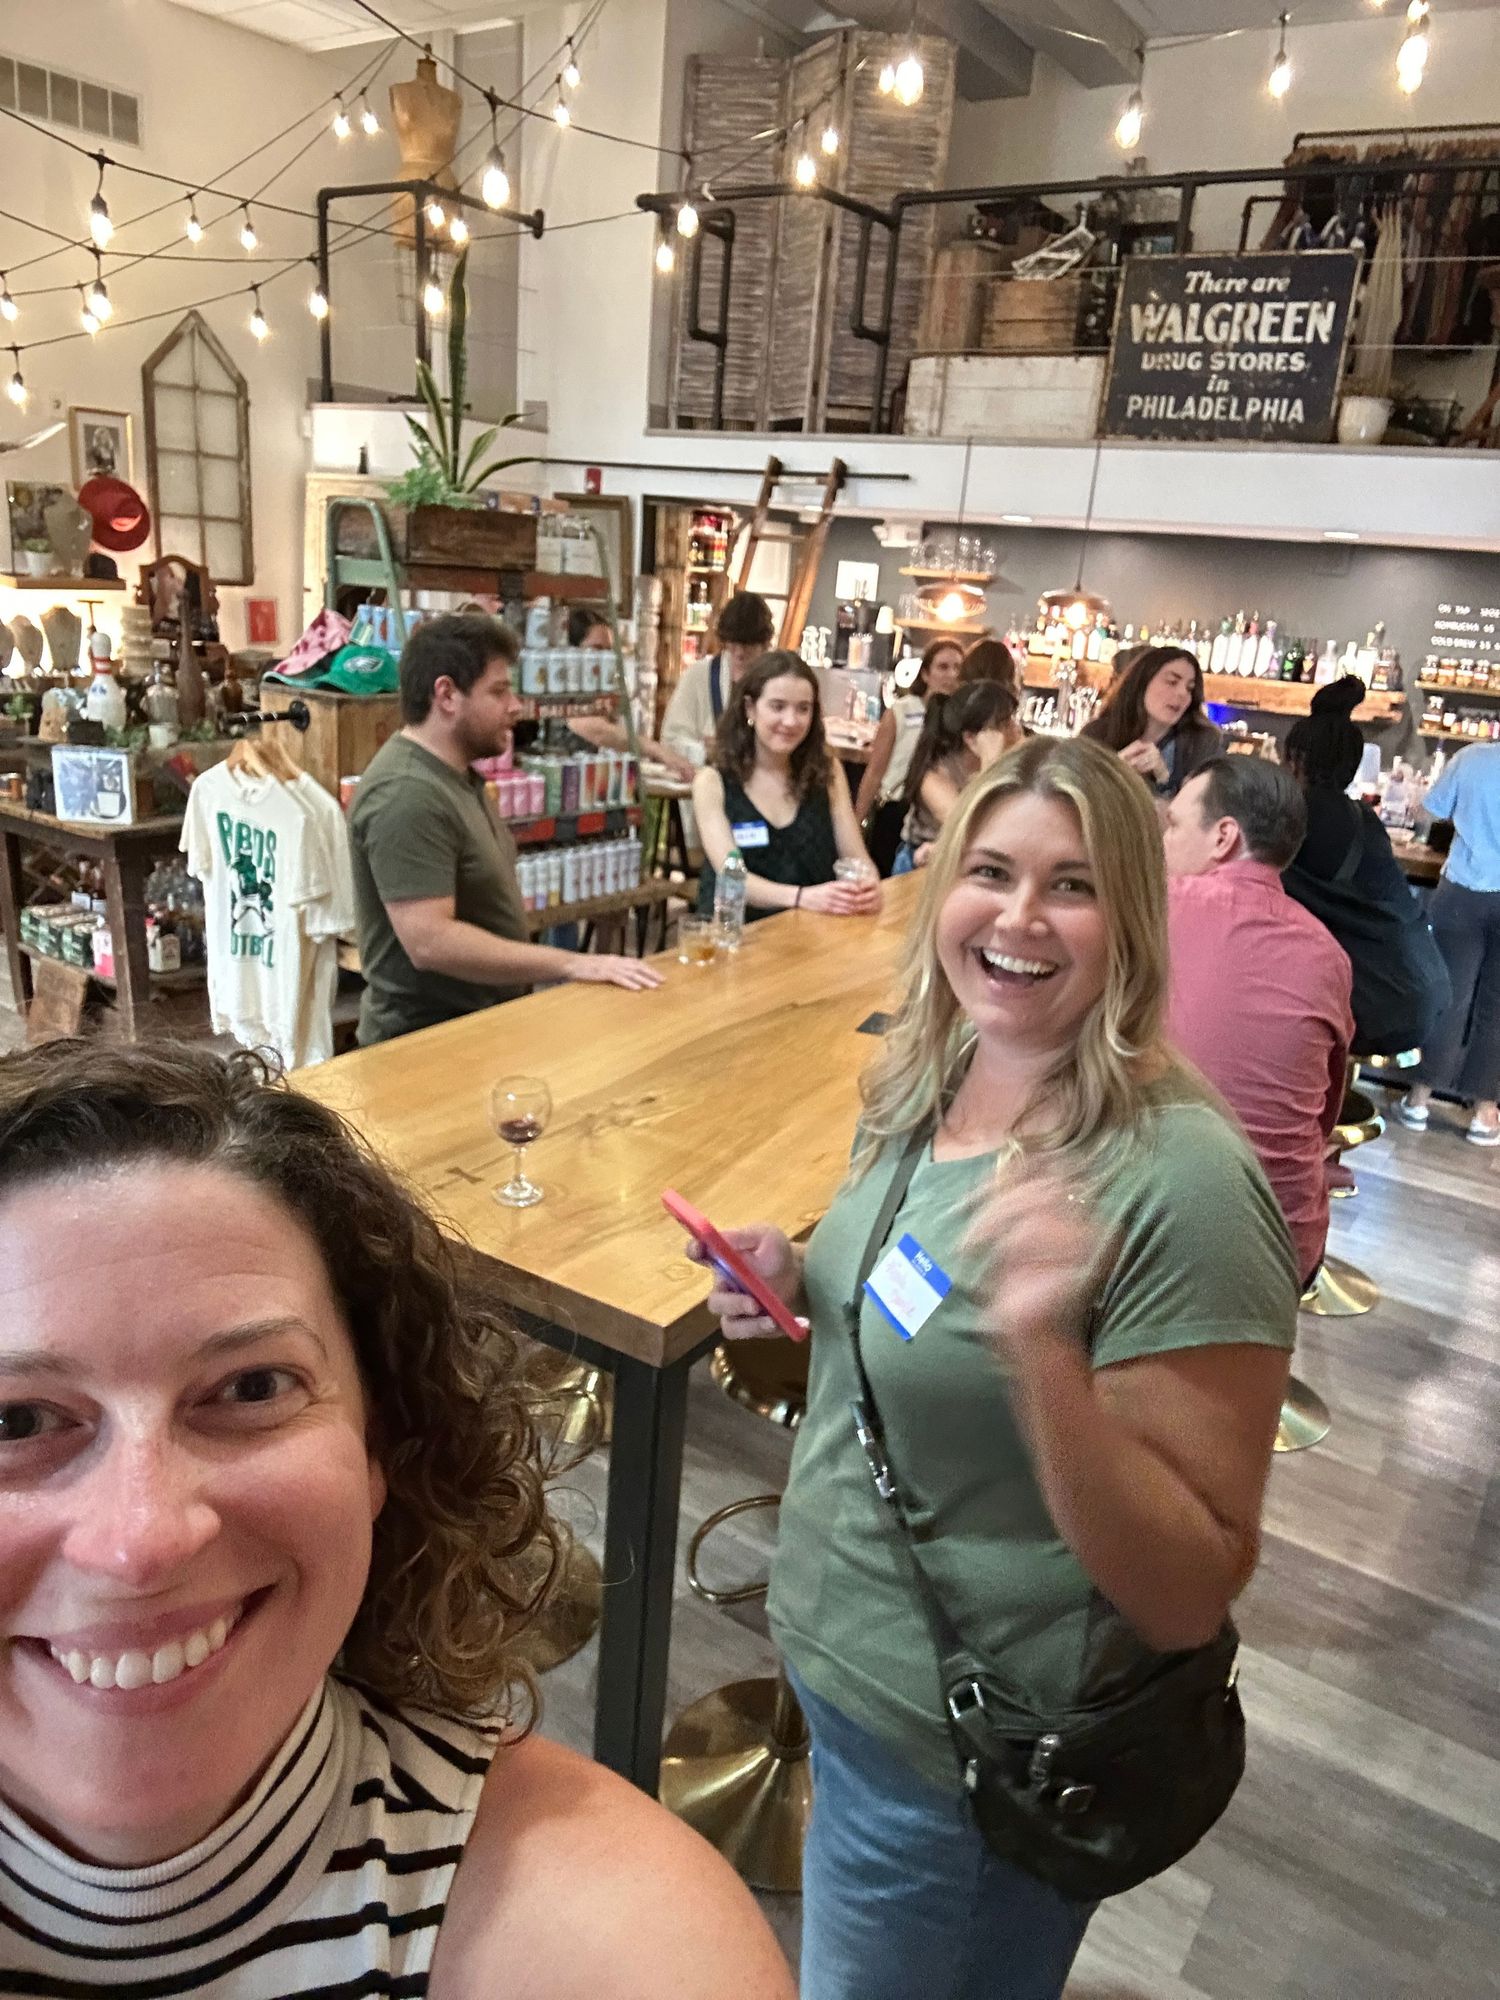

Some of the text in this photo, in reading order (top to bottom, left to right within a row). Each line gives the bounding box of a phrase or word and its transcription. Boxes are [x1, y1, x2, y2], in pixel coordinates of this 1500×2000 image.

[1184, 270, 1291, 294] There are
[1130, 300, 1337, 344] WALGREEN
[1141, 351, 1306, 373] DRUG STORES
[1206, 374, 1230, 393] in
[1126, 394, 1305, 423] PHILADELPHIA
